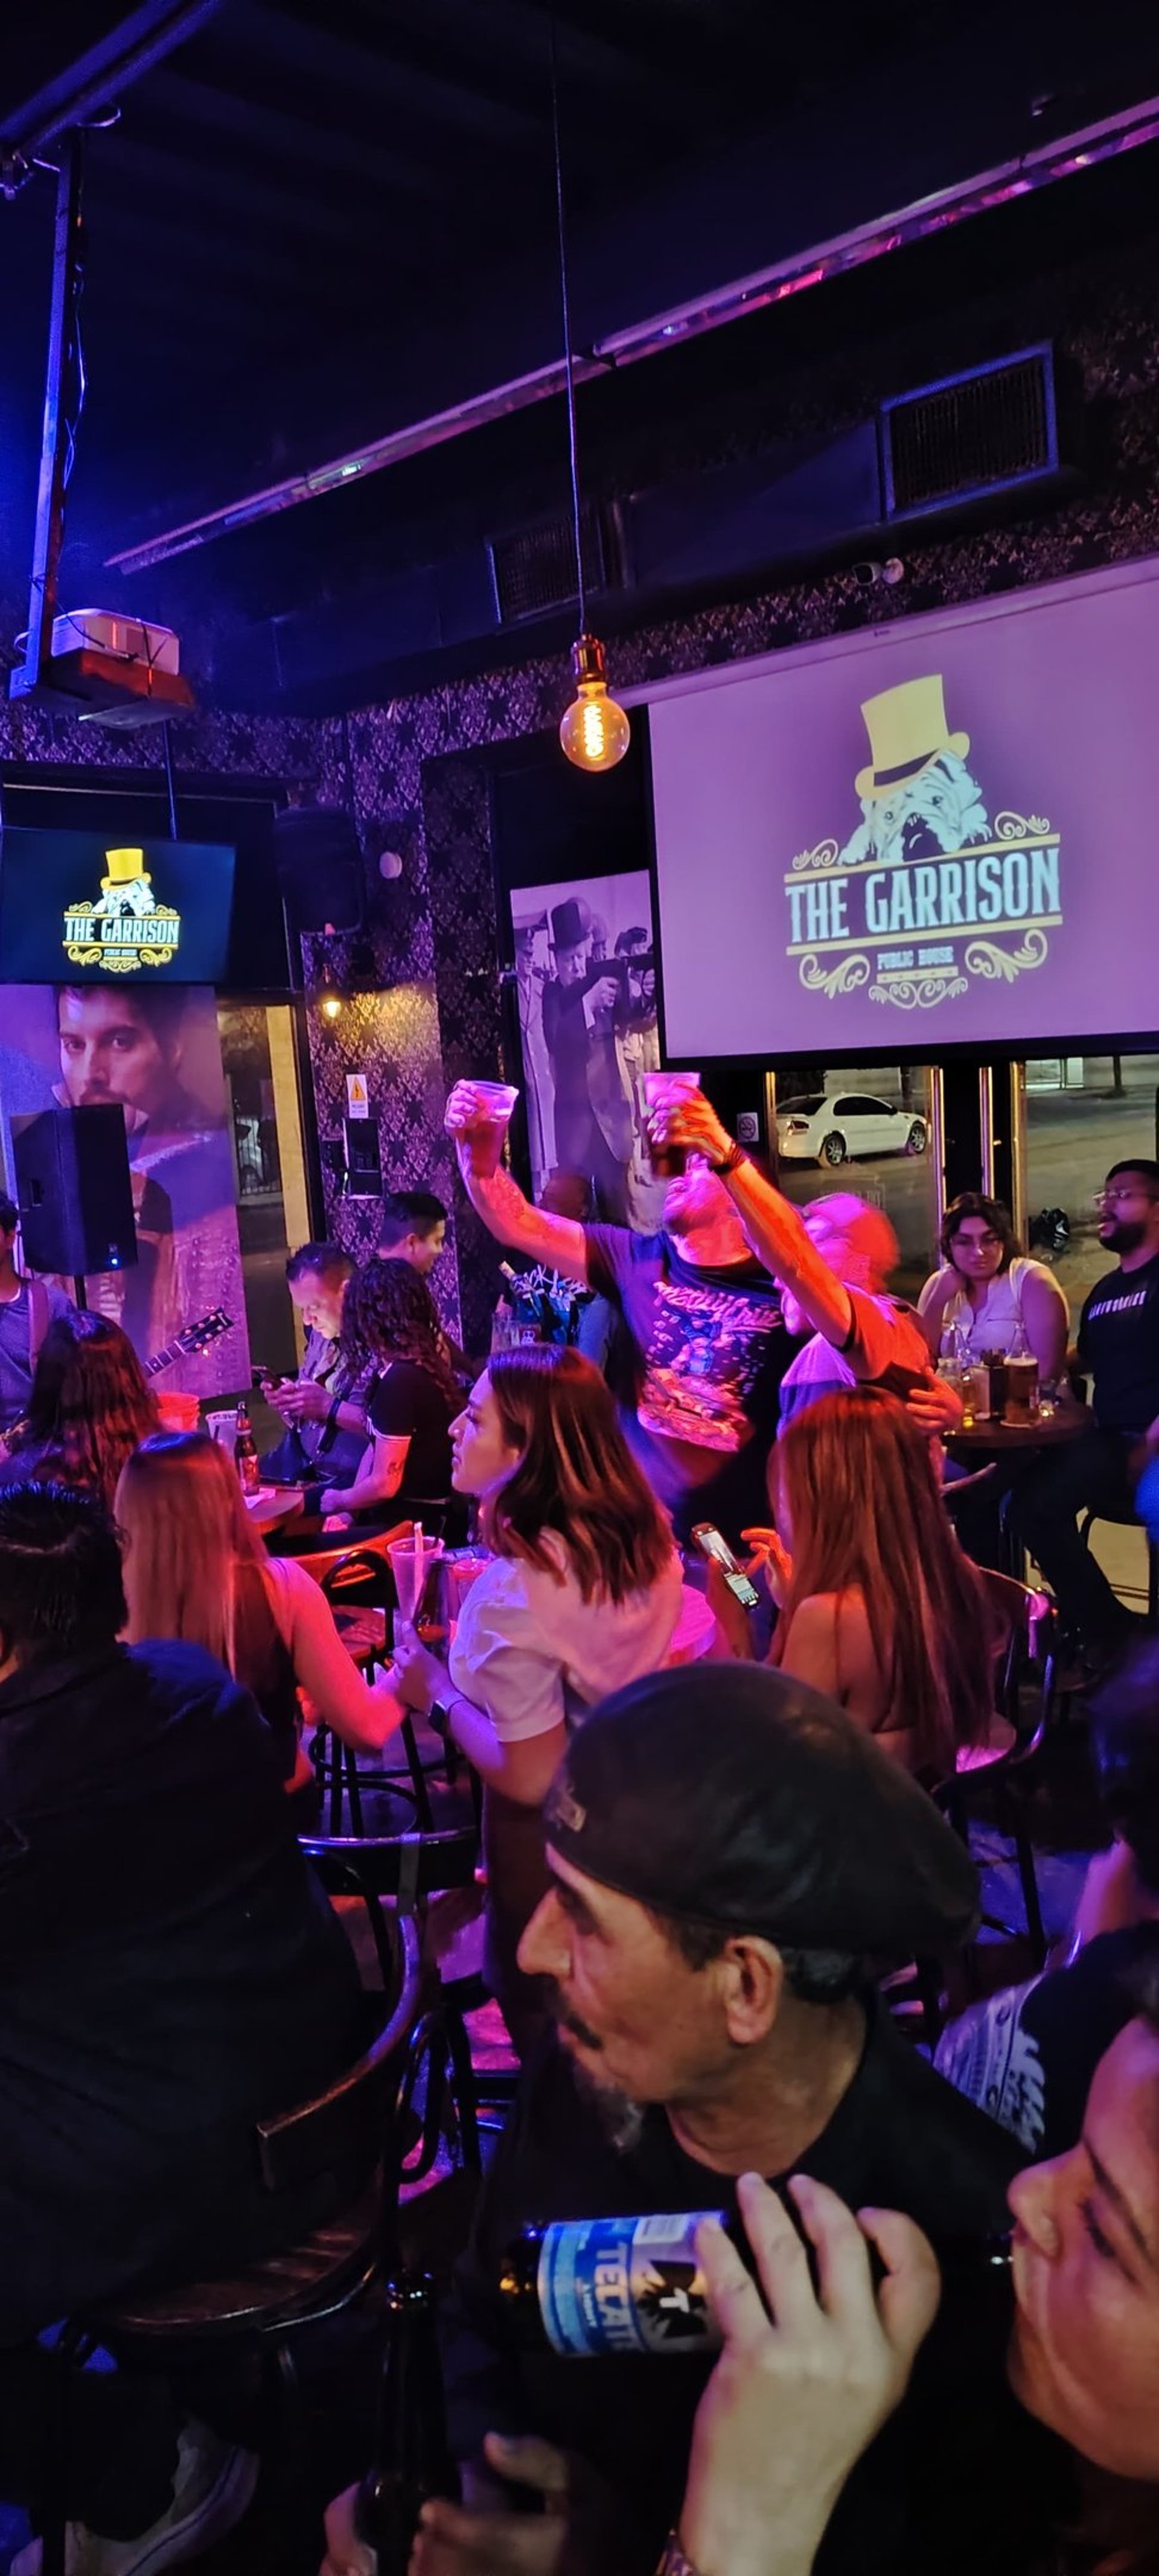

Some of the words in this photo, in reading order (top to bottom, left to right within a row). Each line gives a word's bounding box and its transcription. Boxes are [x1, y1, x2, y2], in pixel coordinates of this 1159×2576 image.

[785, 879, 849, 943] THE
[865, 848, 1061, 934] GARRISON
[64, 917, 95, 942] THE
[101, 918, 179, 943] GARRISON
